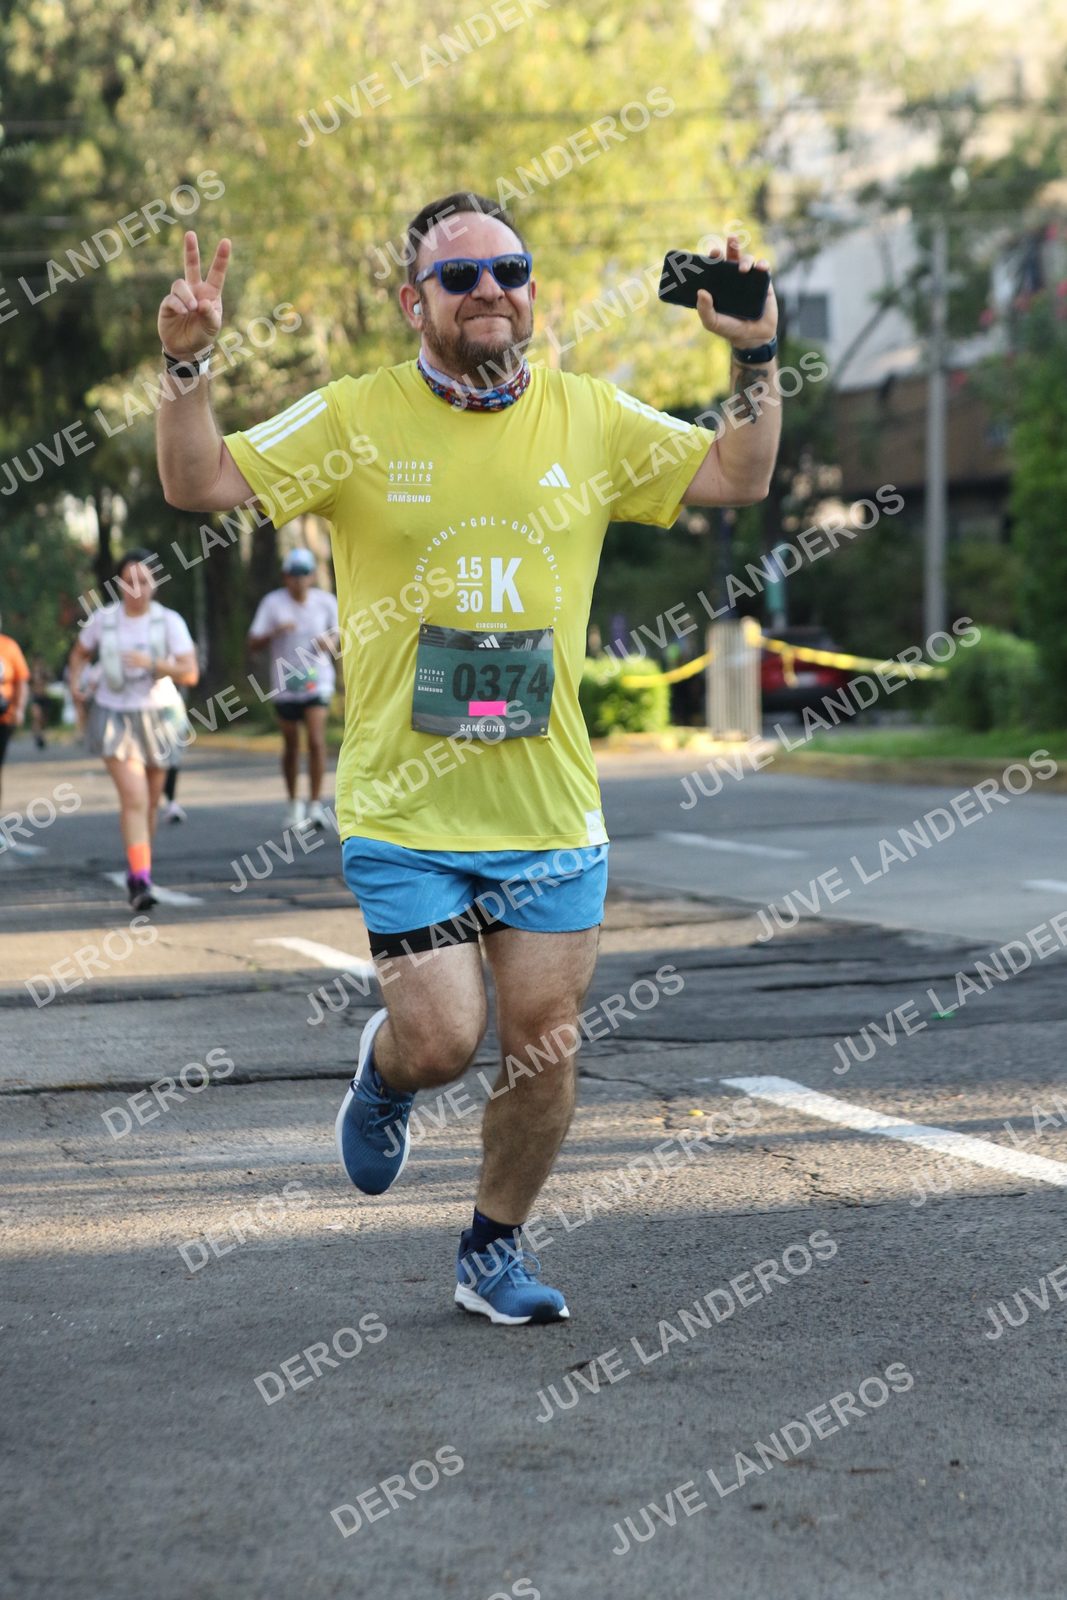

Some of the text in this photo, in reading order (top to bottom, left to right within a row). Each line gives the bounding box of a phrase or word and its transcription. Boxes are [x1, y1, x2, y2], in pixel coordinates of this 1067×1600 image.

[389, 461, 432, 470] ADIDAS
[389, 473, 431, 482] SPLITS
[387, 494, 431, 503] SAMSUNG
[415, 557, 429, 581] GDL
[432, 526, 456, 546] GDL
[470, 516, 495, 528] GDL
[512, 520, 535, 540] GDL
[456, 557, 525, 613] 15 K
[456, 590, 483, 613] 30
[453, 663, 549, 702] 0374
[460, 723, 506, 733] SAMSUNG
